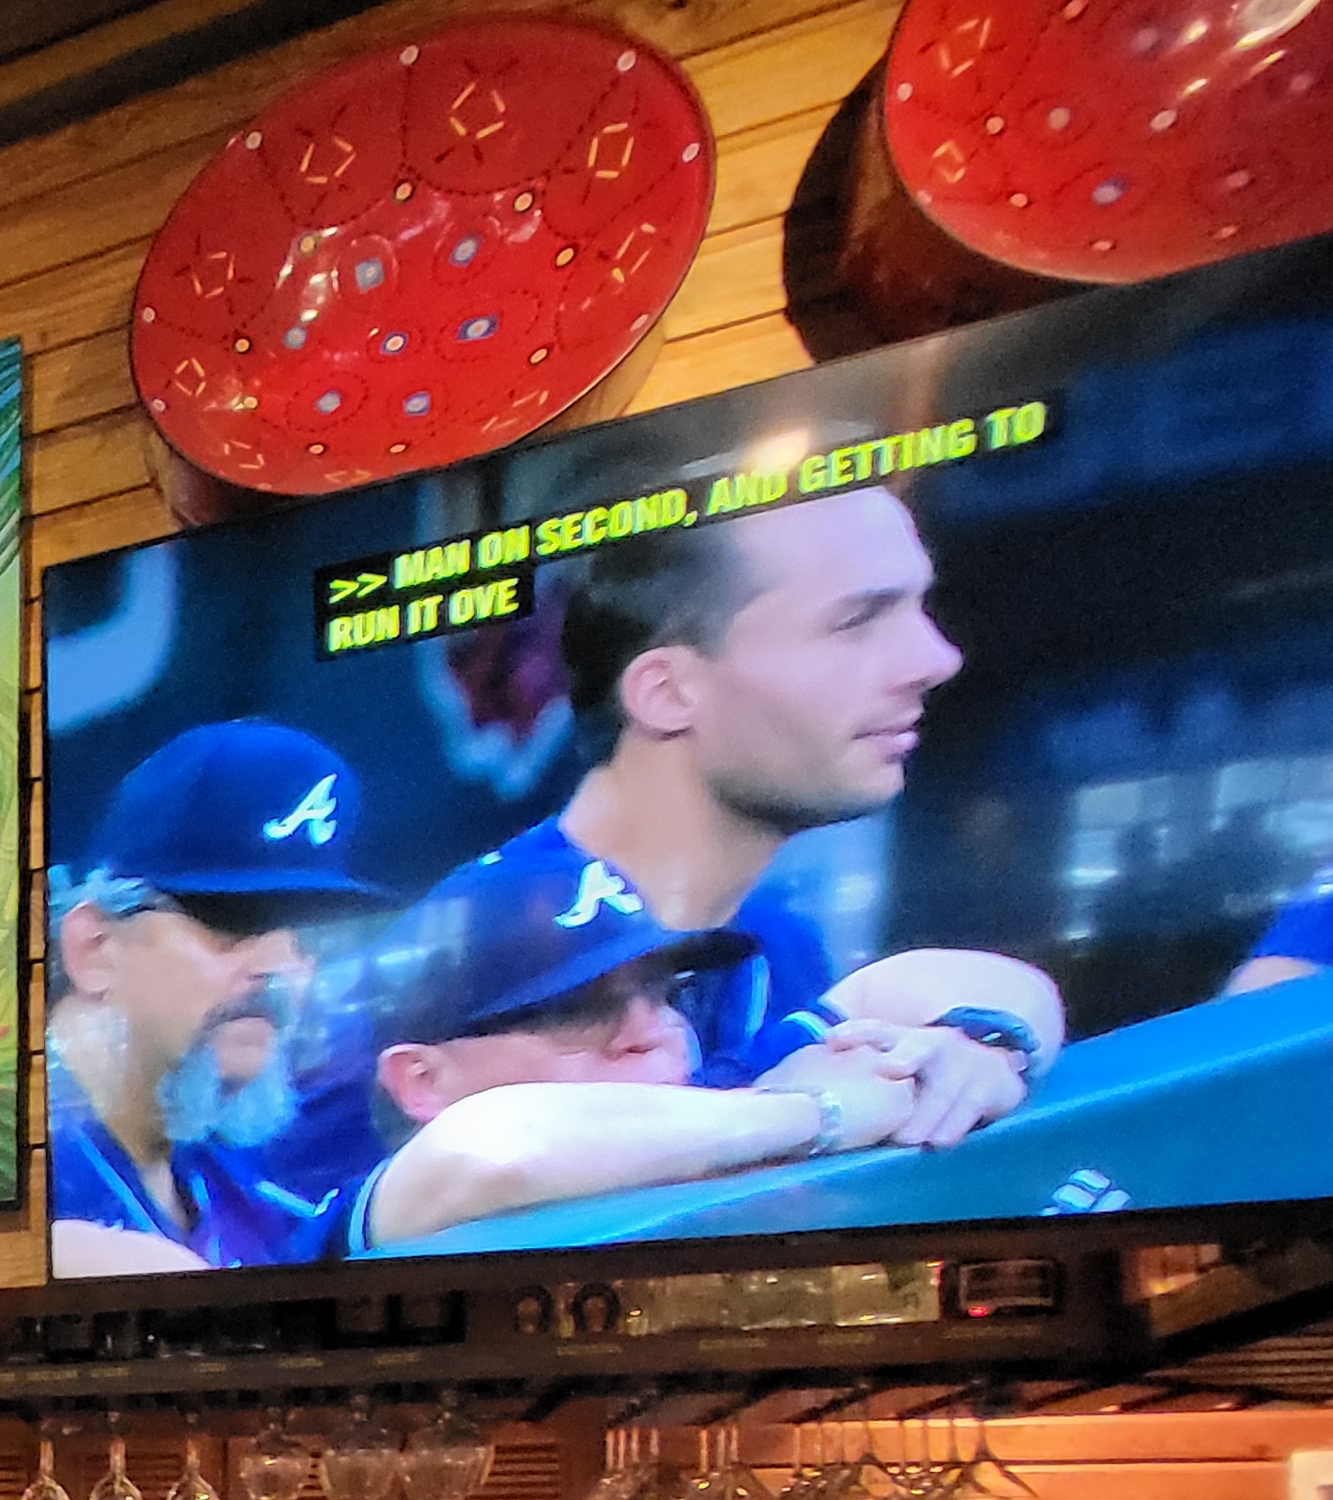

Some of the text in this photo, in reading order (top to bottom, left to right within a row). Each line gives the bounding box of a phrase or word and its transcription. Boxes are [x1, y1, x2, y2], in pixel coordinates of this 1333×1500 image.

[394, 539, 470, 588] MAN
[478, 525, 532, 569] ON
[535, 487, 699, 558] SECOND,
[706, 471, 787, 515] AND
[797, 418, 978, 493] GETTING
[985, 401, 1047, 449] TO
[328, 578, 520, 652] RUN IT OVE
